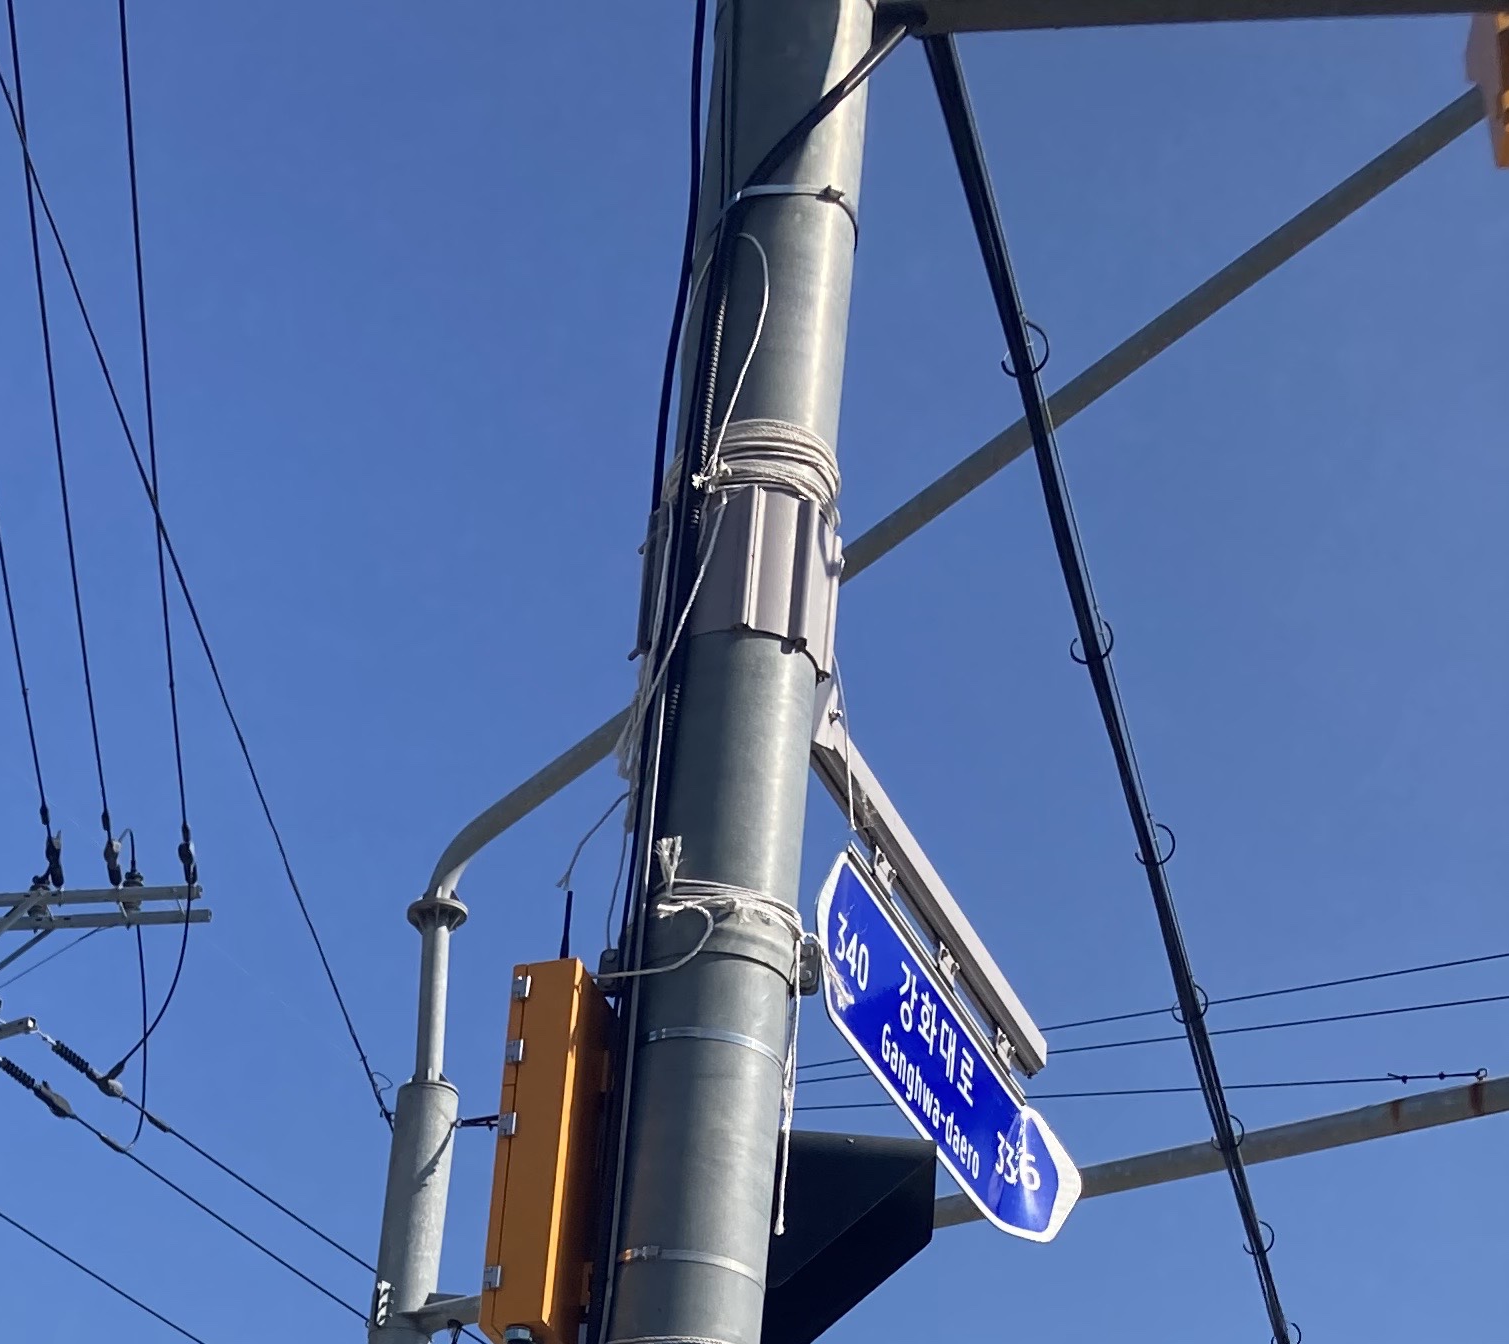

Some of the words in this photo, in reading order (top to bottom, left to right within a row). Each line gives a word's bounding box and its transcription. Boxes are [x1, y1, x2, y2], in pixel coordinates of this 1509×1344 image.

[834, 912, 870, 992] 340
[899, 961, 975, 1108] 강화대로
[994, 1130, 1041, 1192] 336
[881, 1023, 980, 1181] Ganghwa-daero
